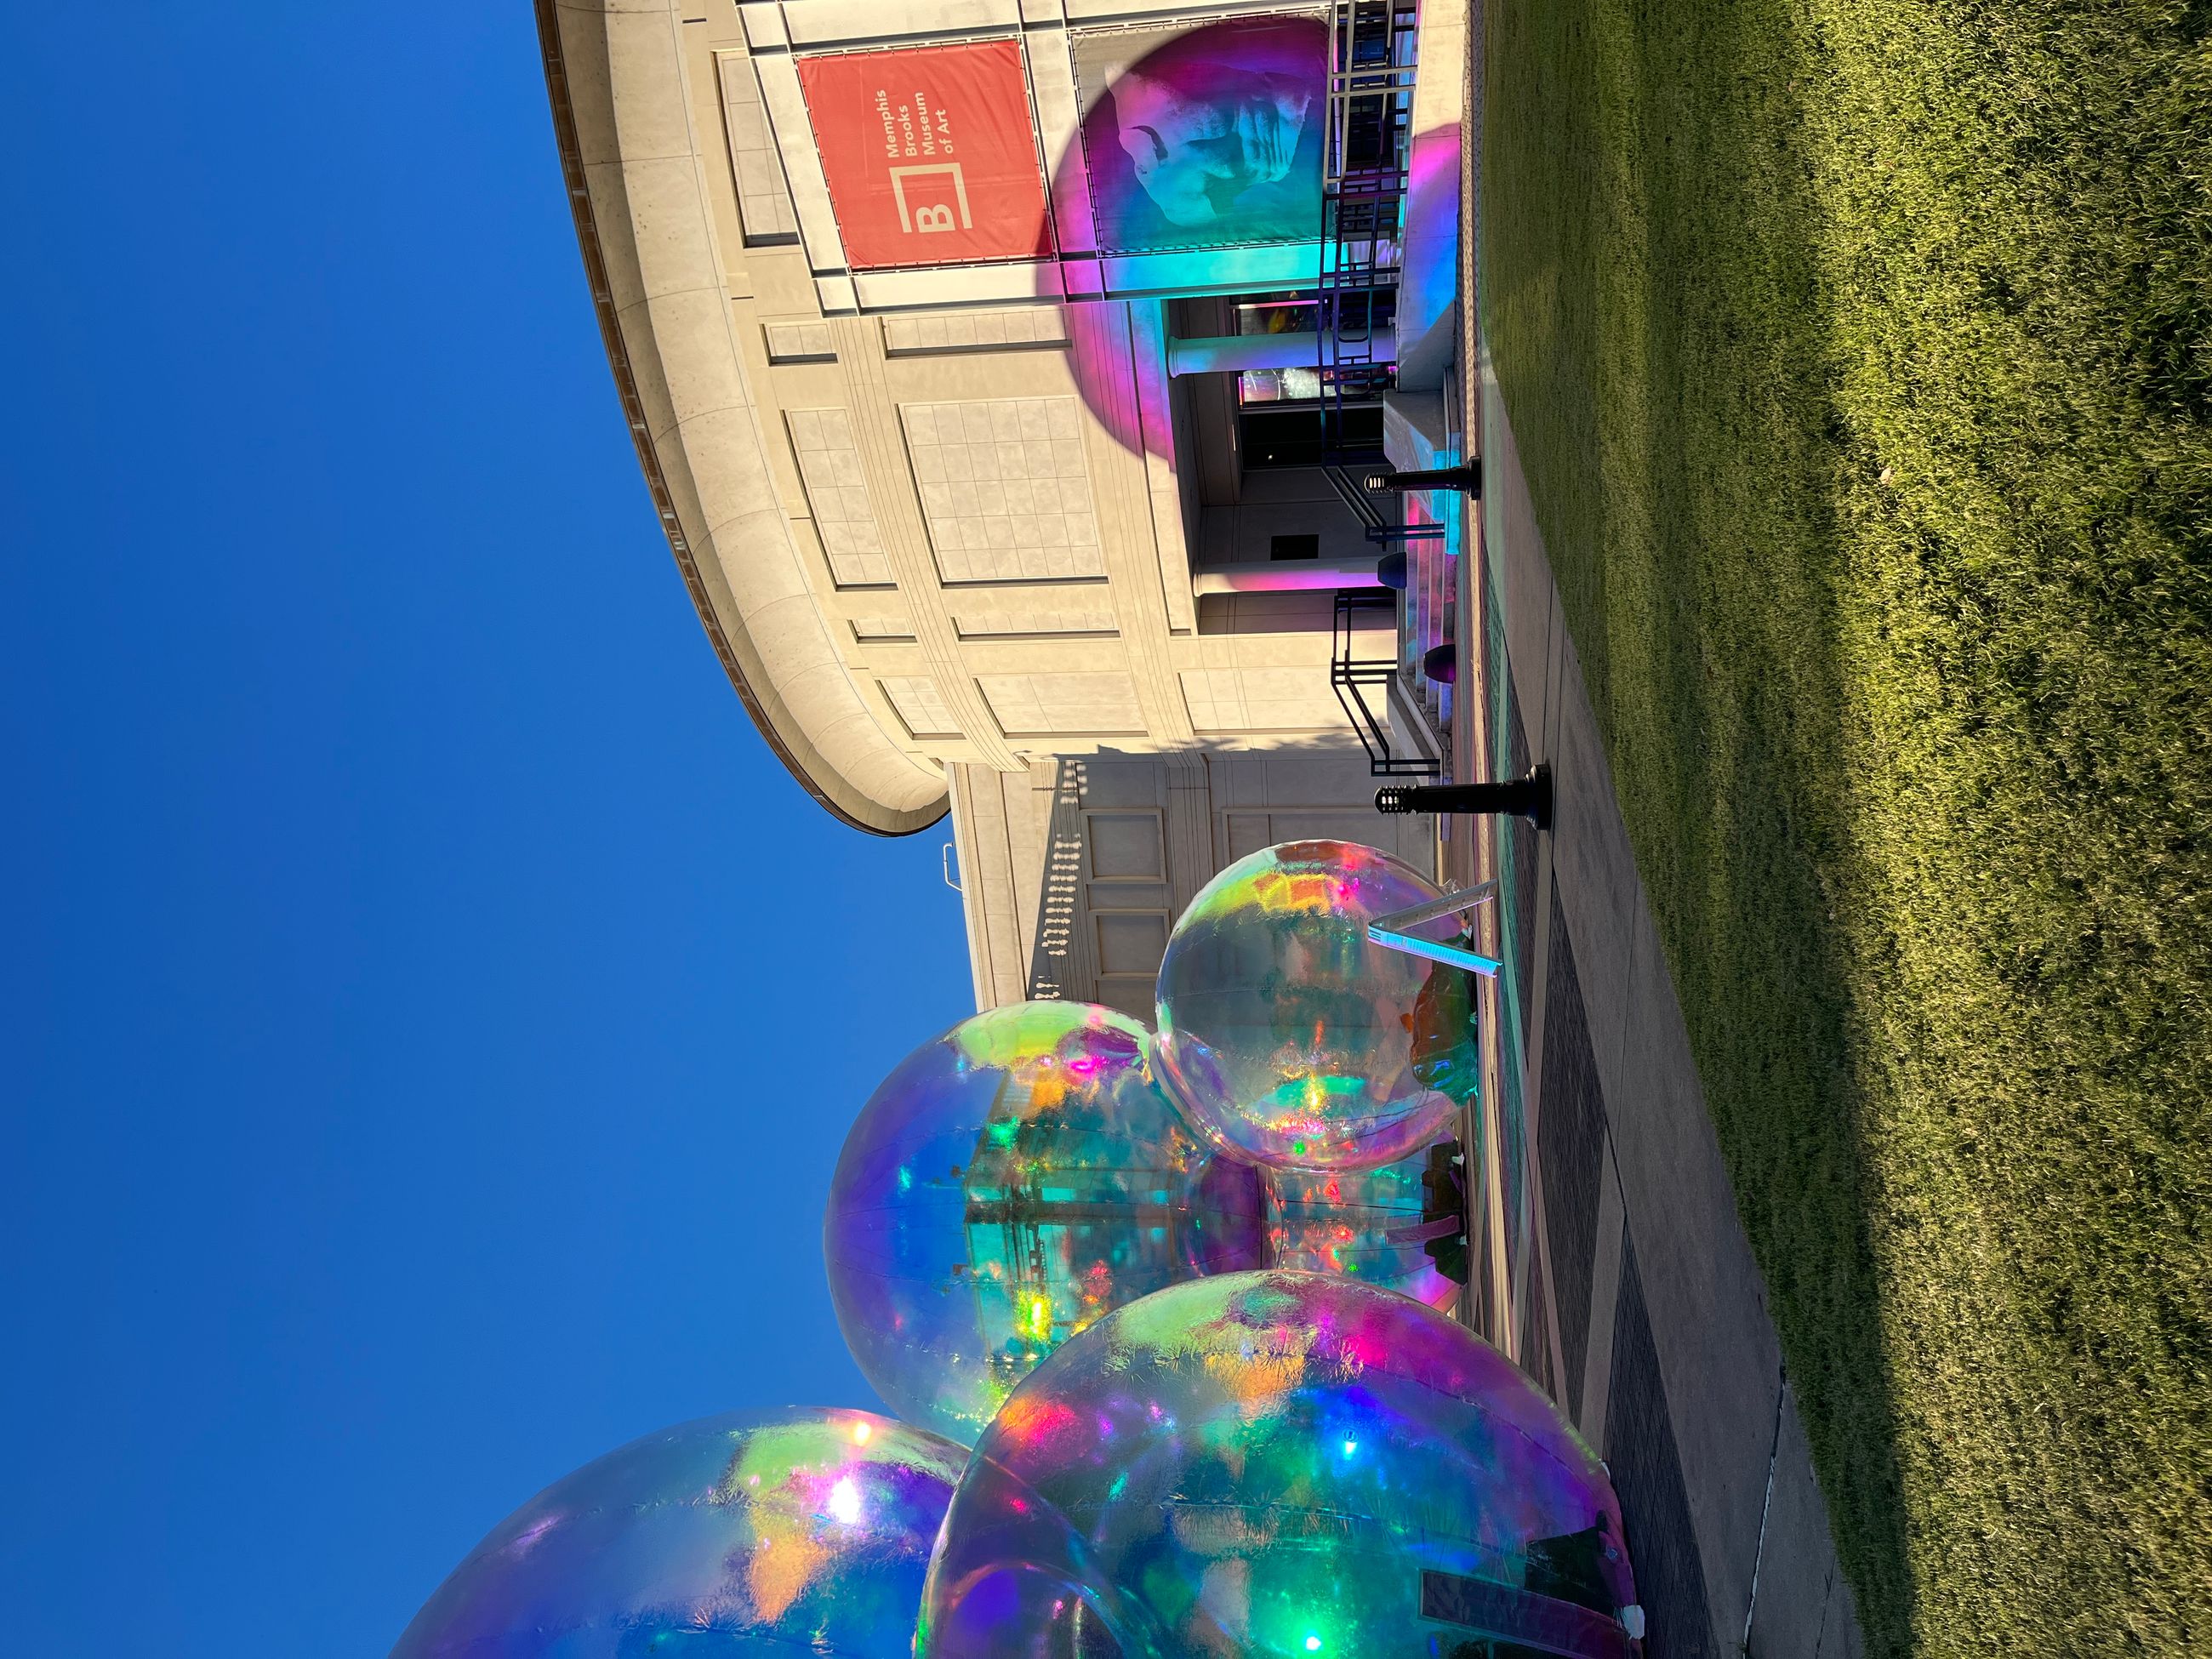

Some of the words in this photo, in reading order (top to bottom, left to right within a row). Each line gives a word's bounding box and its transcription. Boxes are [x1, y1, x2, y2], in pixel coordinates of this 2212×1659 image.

[875, 89, 899, 158] Memphis
[898, 105, 918, 157] Brooks
[915, 92, 936, 155] Museum
[935, 109, 950, 134] Art
[938, 138, 954, 154] of
[915, 203, 955, 233] B
